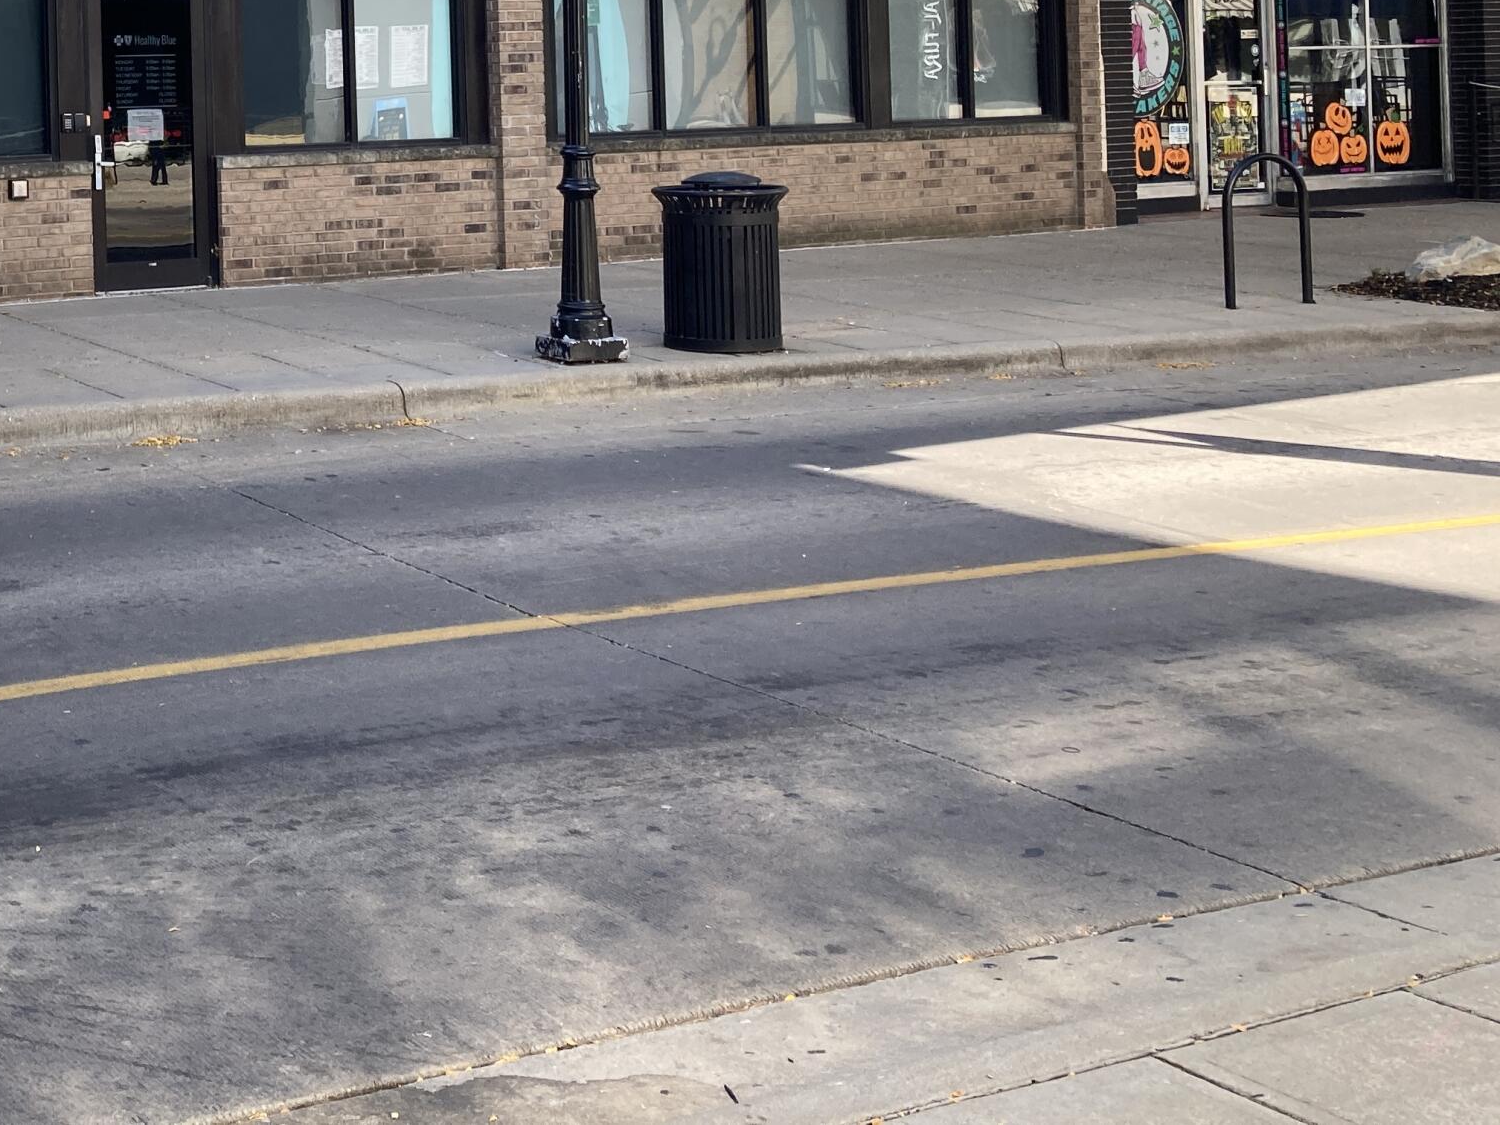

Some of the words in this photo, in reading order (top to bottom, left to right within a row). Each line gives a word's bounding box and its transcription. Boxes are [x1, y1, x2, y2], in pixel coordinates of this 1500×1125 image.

[134, 35, 160, 47] Healthy
[161, 35, 177, 45] Blue
[1133, 59, 1180, 114] AKERS
